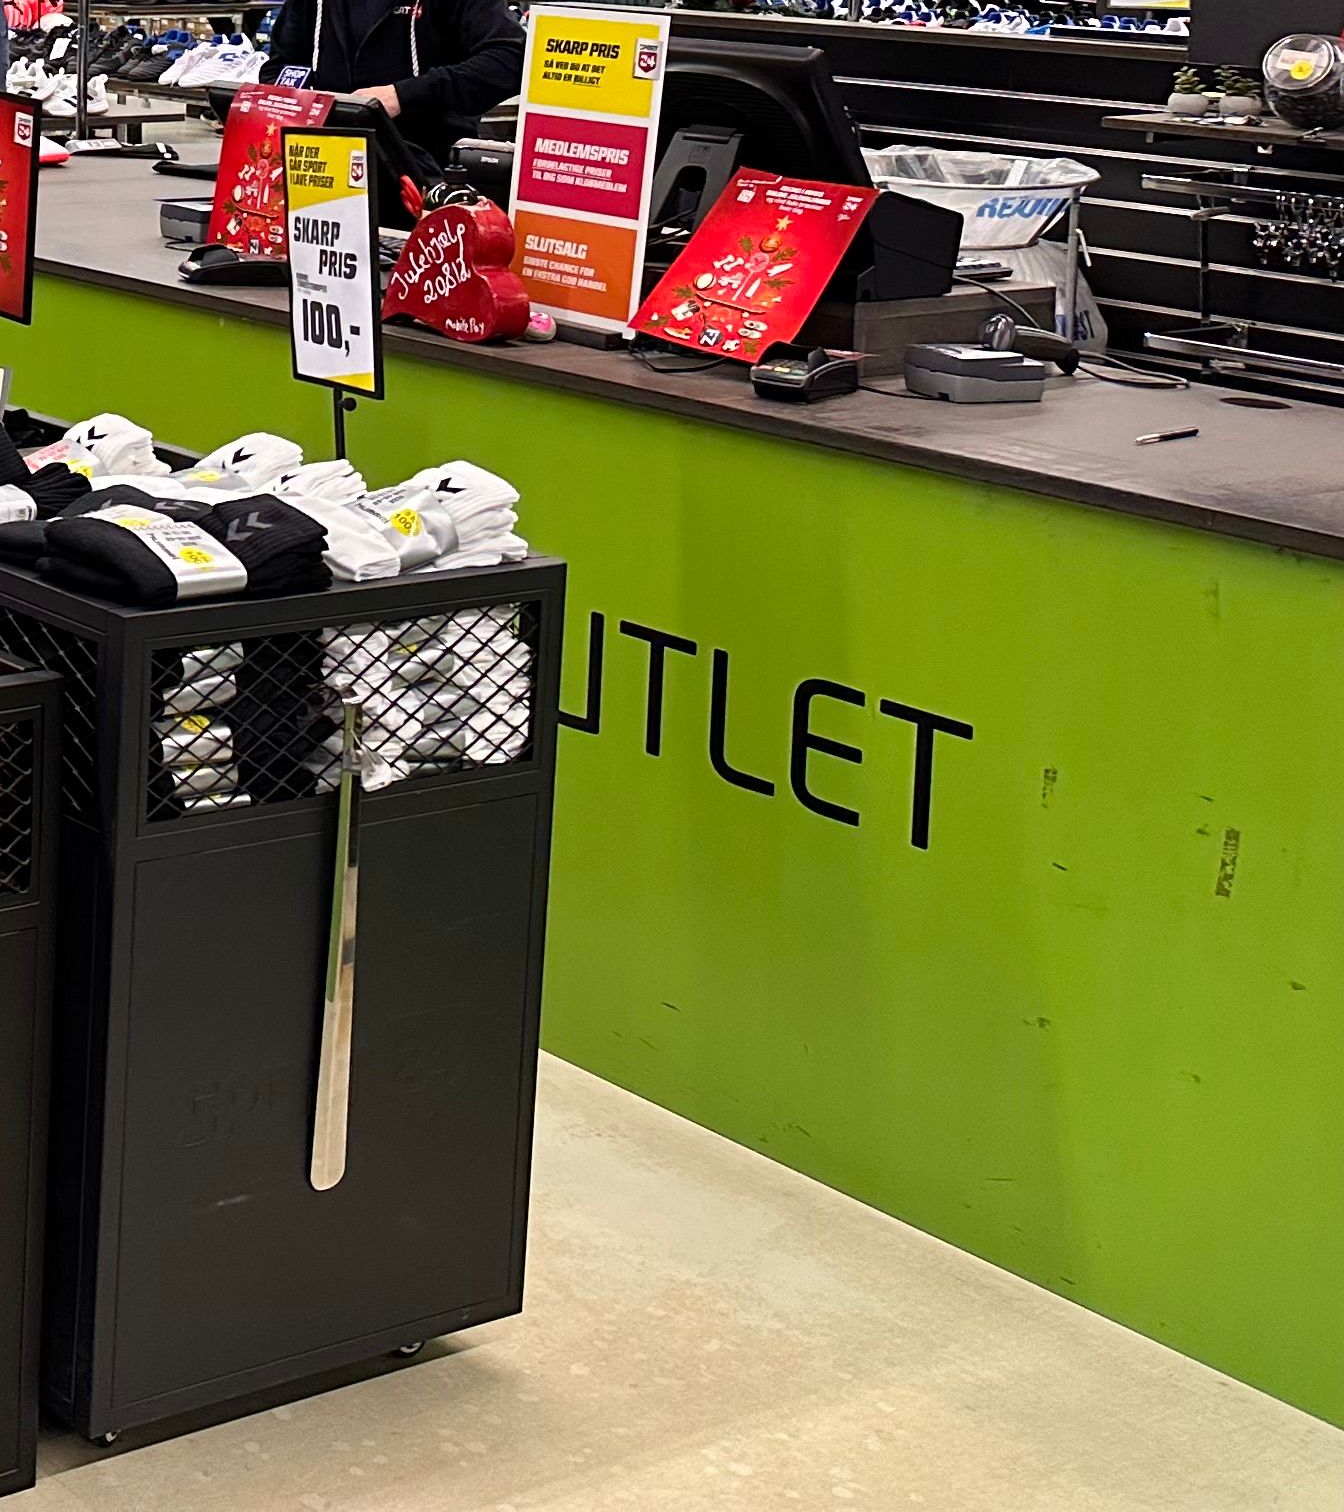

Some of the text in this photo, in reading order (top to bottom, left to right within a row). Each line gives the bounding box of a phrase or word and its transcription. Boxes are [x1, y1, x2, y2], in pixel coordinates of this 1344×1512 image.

[546, 38, 620, 59] SKARP PRIS
[640, 54, 656, 68] 24
[289, 142, 305, 158] NÅR
[534, 137, 630, 165] MEDLEMSPRIS
[302, 160, 327, 173] SPORT
[294, 216, 340, 247] SKARP
[390, 219, 465, 300] Julehjælp
[524, 234, 588, 260] SLUTSALG
[318, 249, 357, 280] PRIS
[302, 298, 360, 357] 100,-
[558, 611, 974, 851] UTLET
